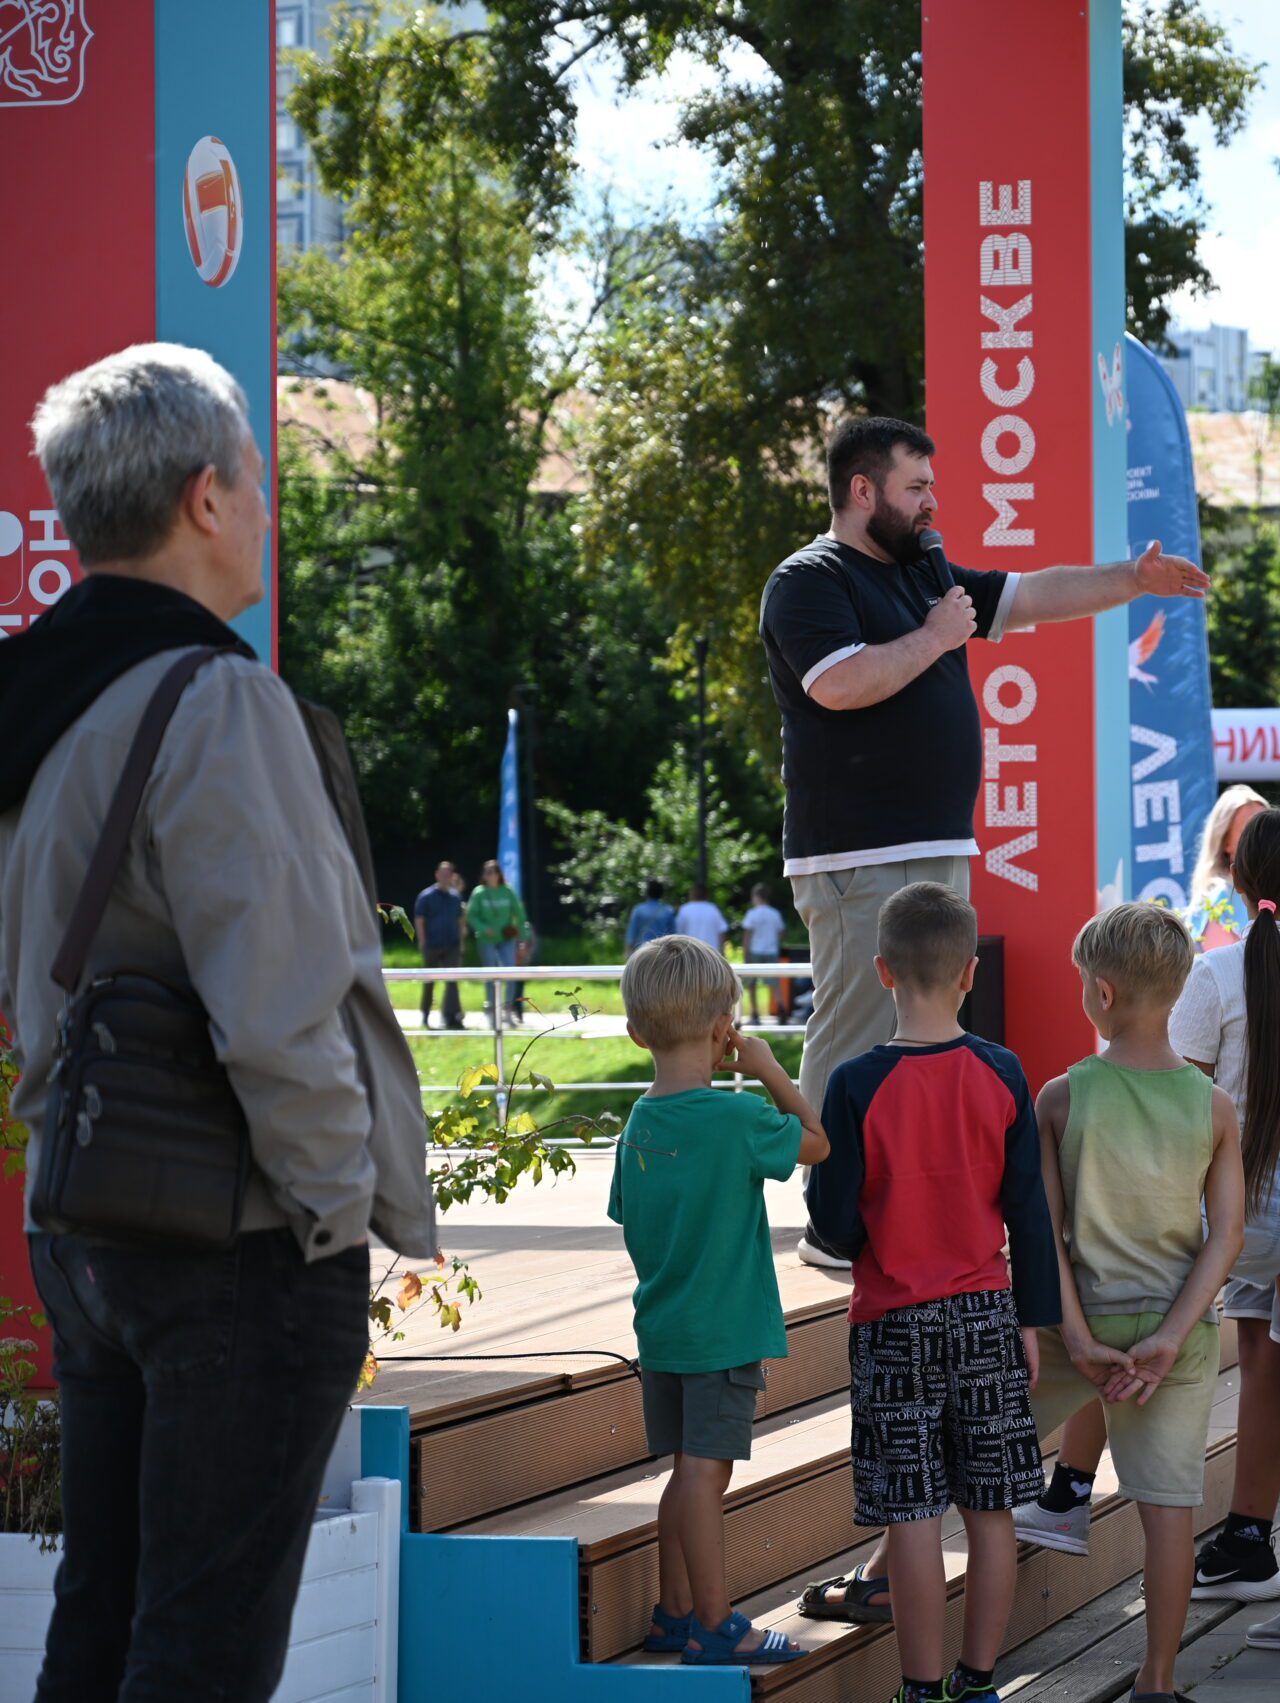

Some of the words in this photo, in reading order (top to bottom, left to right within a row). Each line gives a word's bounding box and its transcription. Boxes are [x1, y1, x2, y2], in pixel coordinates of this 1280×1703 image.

[979, 179, 1036, 547] МОСКВЕ
[982, 664, 1039, 893] ЛЕТО
[880, 1312, 918, 1323] MPORIO
[857, 1325, 868, 1362] MPORIO
[909, 1323, 921, 1364] EMPORIO
[875, 1365, 910, 1375] ARMANI
[875, 1410, 926, 1422] EMPORIO
[1009, 1416, 1034, 1430] ARMA
[917, 1420, 928, 1461] EMPORIO
[966, 1475, 1002, 1486] ARMAN
[1010, 1467, 1043, 1483] MPORIO
[1003, 1484, 1013, 1510] ARMA
